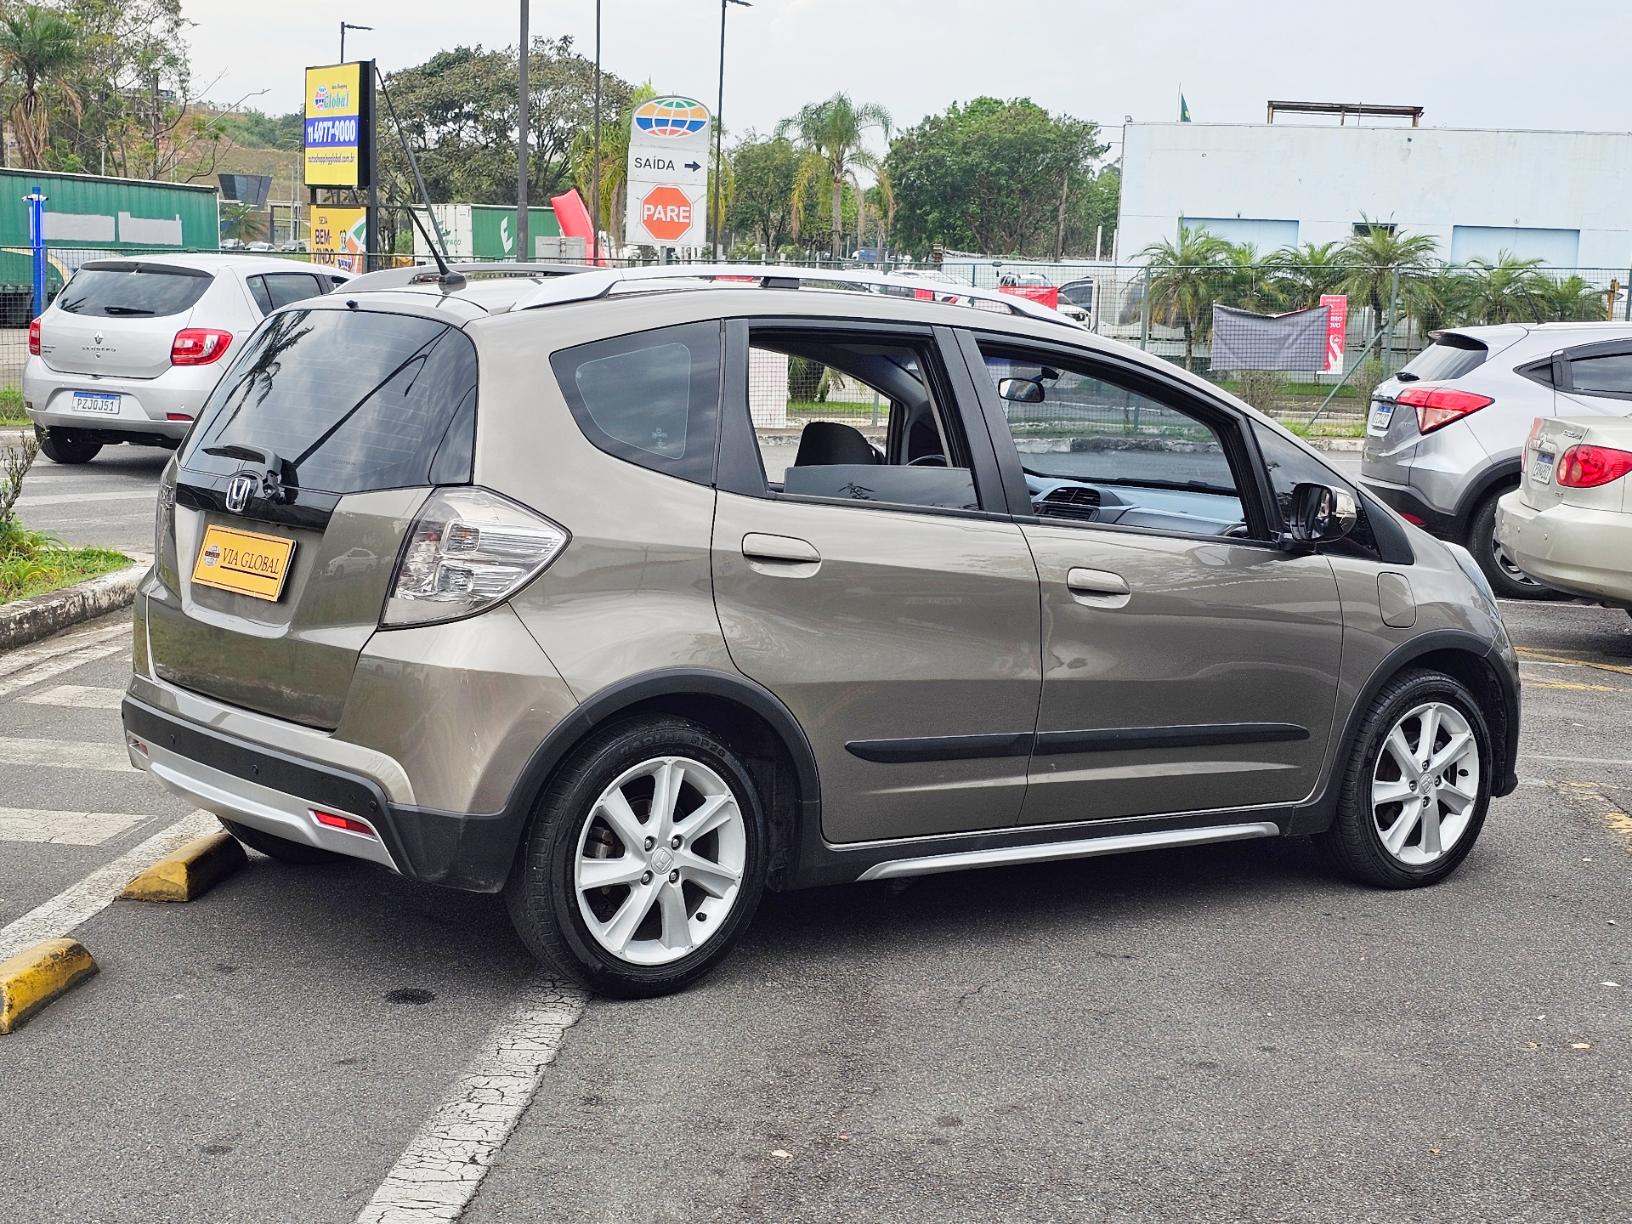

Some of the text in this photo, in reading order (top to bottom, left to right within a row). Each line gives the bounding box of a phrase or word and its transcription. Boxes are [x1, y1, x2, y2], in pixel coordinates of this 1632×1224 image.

[307, 120, 356, 143] 11 4977-9000
[634, 156, 675, 171] SAÍDA
[643, 204, 690, 223] PARE
[315, 228, 333, 246] BEM-
[312, 247, 335, 265] VINDO
[222, 548, 238, 565] VIA
[240, 552, 279, 574] GLOBAL
